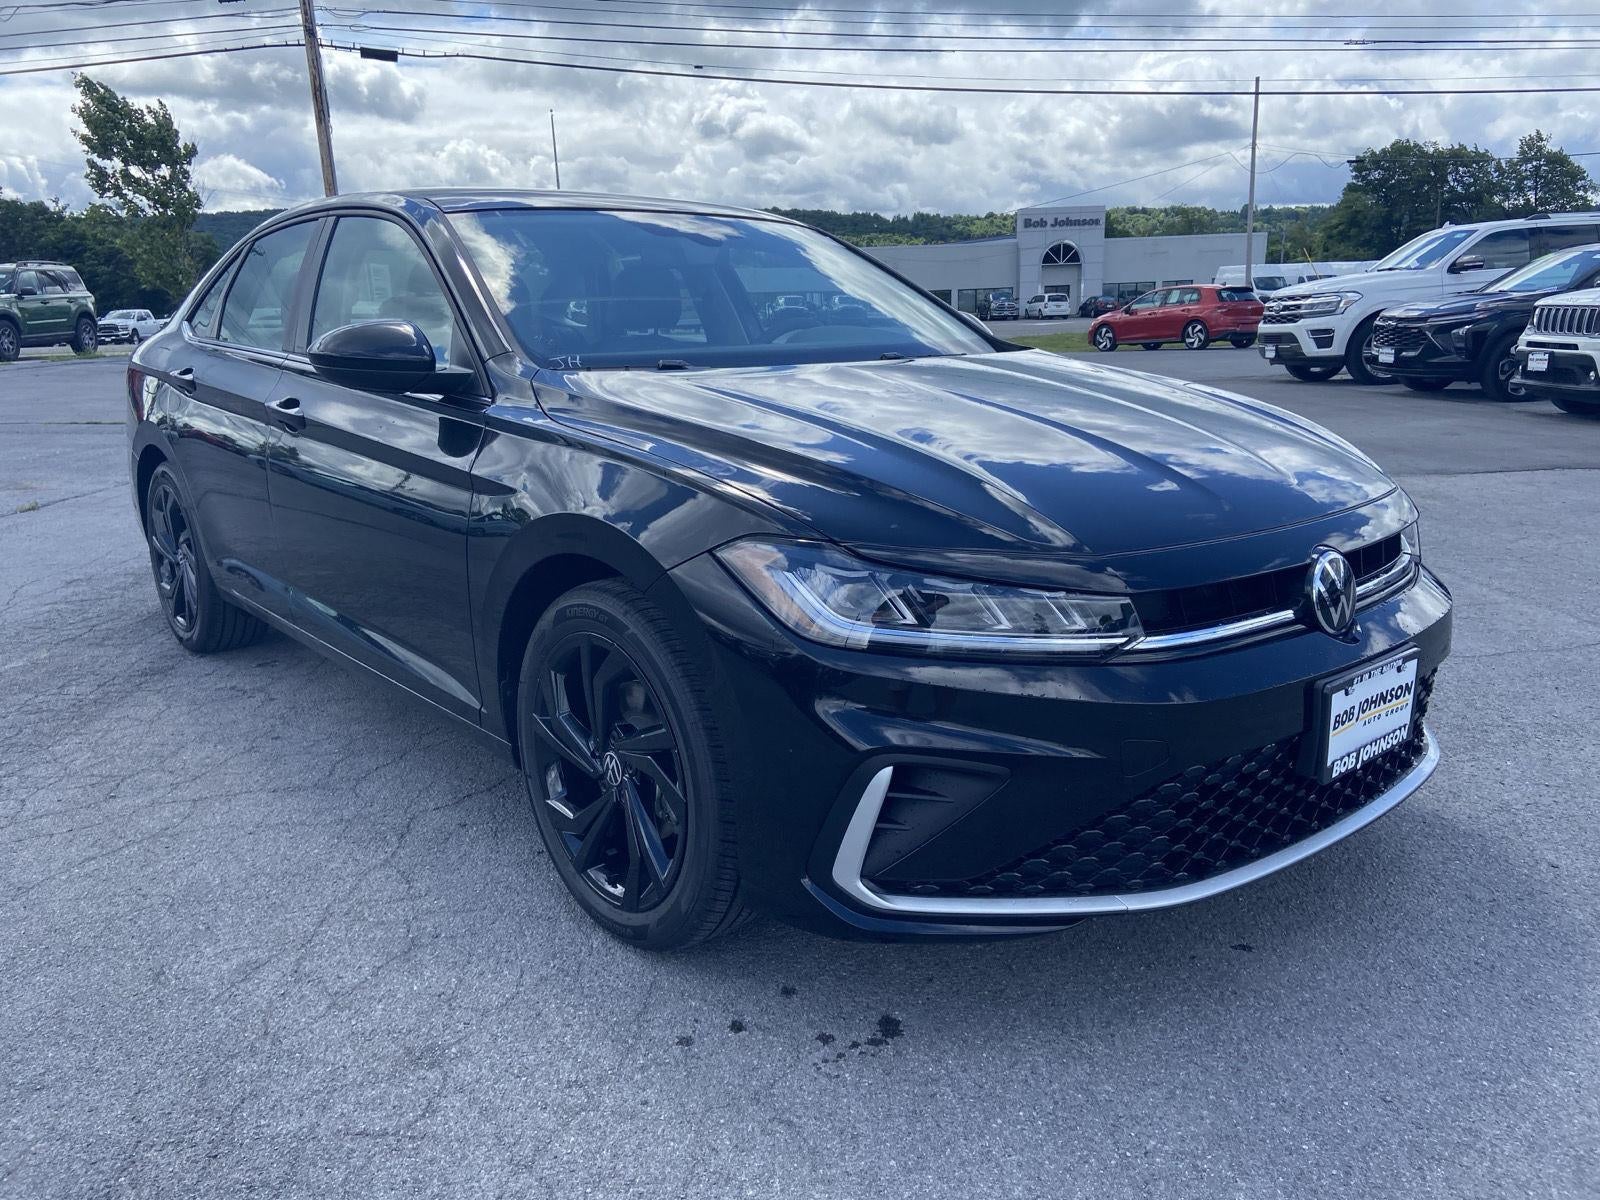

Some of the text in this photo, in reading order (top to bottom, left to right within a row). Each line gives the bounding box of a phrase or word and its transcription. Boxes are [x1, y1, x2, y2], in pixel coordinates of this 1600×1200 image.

[1023, 216, 1102, 228] Bob Johnson
[1332, 681, 1414, 731] BOB JOHNSON
[1363, 703, 1409, 727] AUTO GROUP
[1331, 723, 1409, 778] BOB JOHNSON
